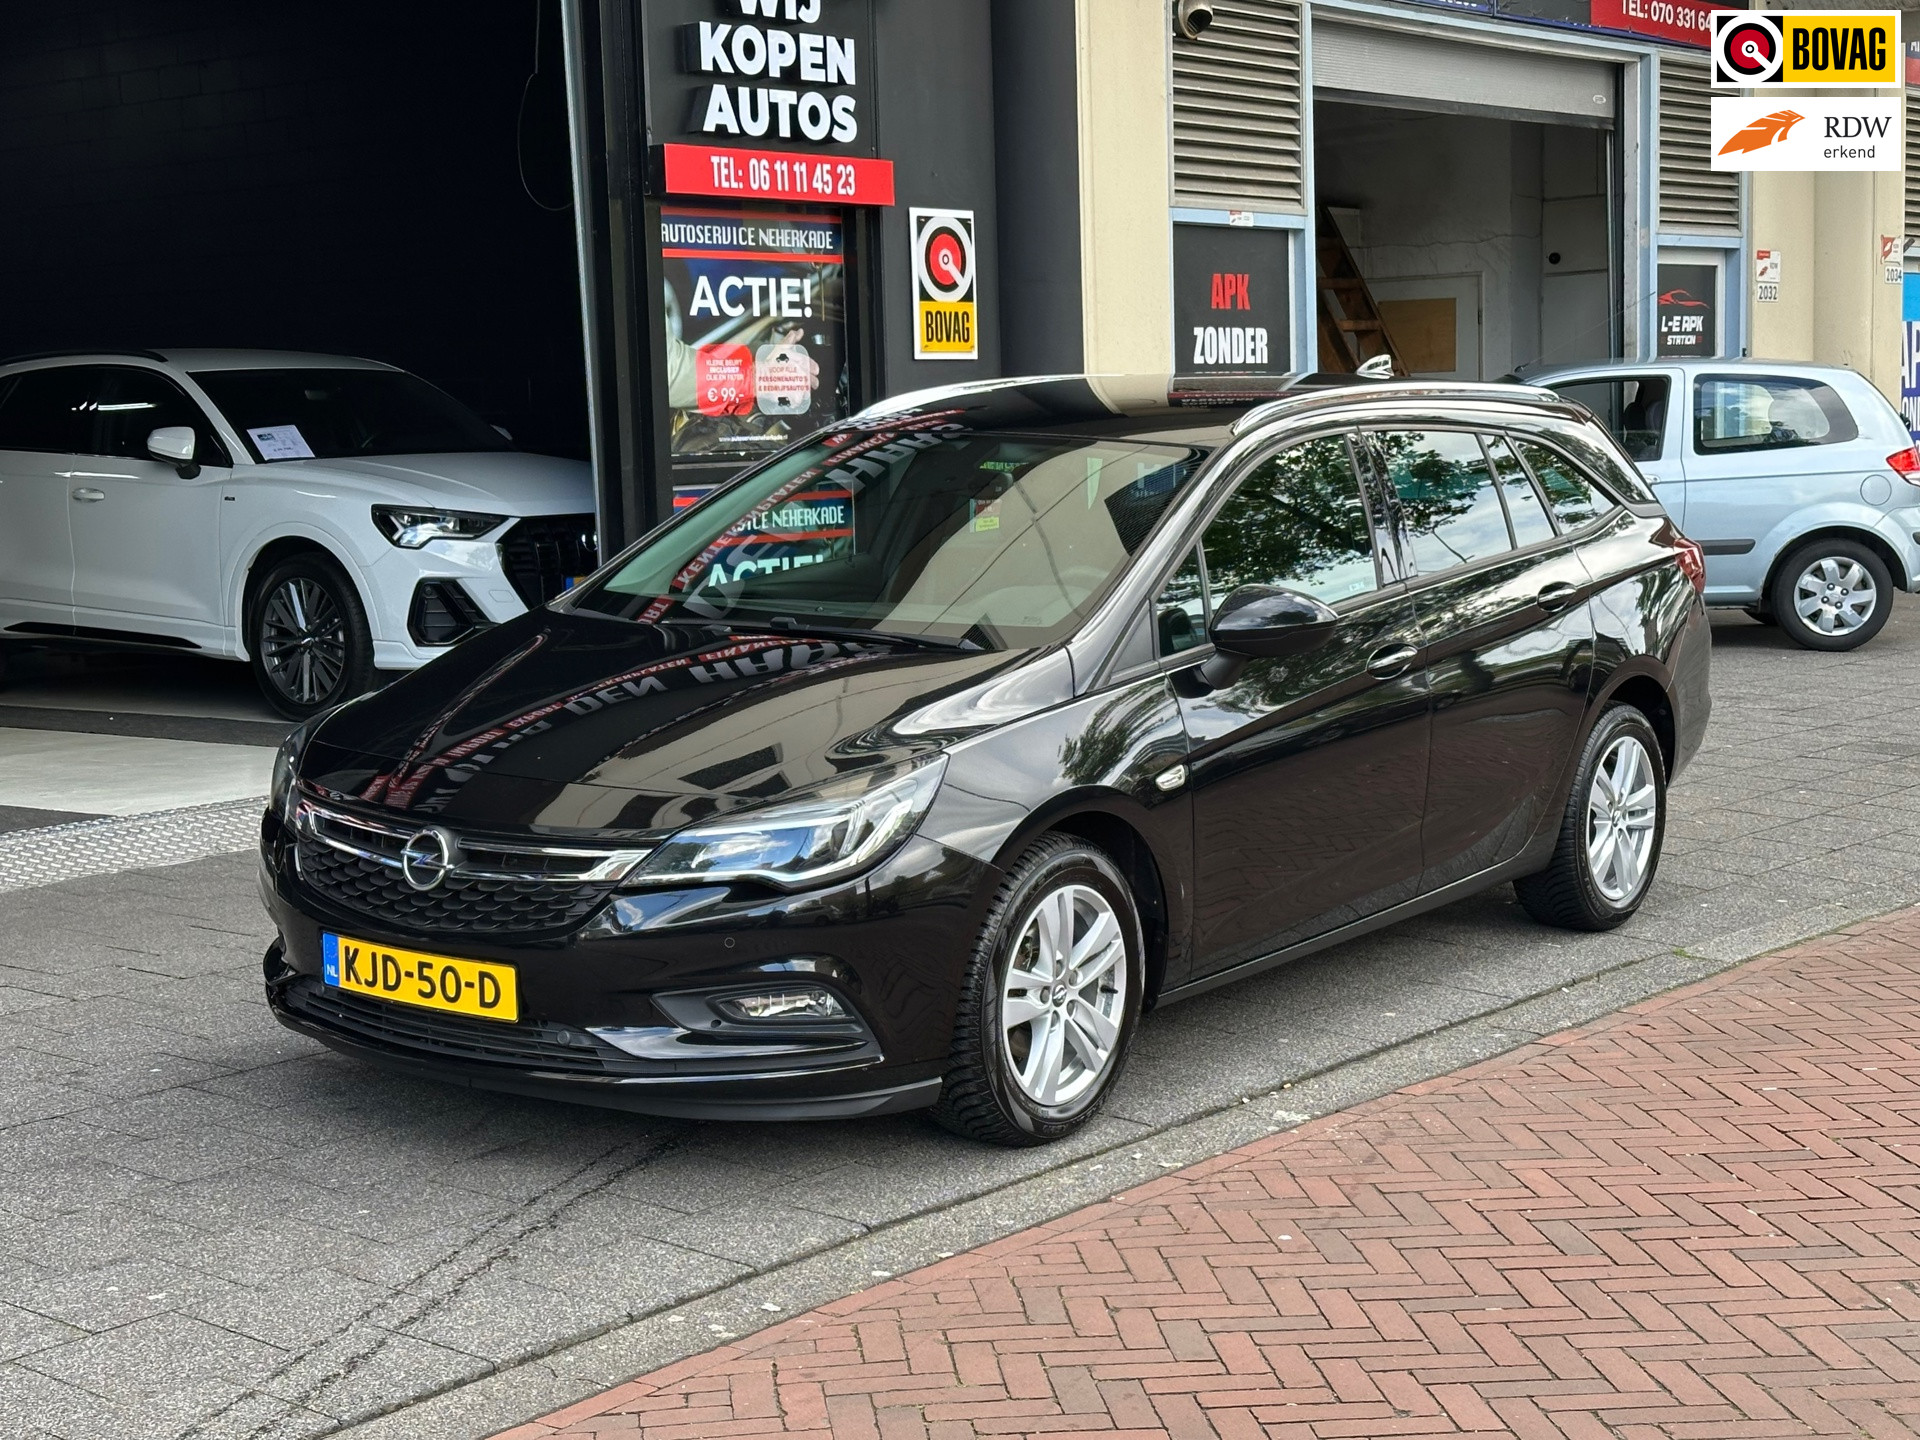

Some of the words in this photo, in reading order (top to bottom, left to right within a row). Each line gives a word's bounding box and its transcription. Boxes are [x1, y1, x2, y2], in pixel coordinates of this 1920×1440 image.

[1622, 0, 1648, 19] TEL:
[1651, 0, 1674, 25] 070
[1676, 6, 1696, 30] 331
[699, 20, 856, 86] KOPEN
[703, 83, 858, 143] AUTOS
[710, 155, 744, 189] TEL:
[748, 157, 771, 191] 06
[774, 160, 789, 192] 11
[793, 162, 808, 193] 11
[812, 163, 833, 195] 45
[836, 164, 856, 197] 23
[661, 222, 756, 246] AUTOSERVICE
[758, 228, 834, 250] NEHERKADE
[689, 275, 814, 319] ACTIE!
[1210, 272, 1251, 311] APK
[1758, 285, 1778, 300] 2032
[925, 310, 970, 343] BOVAG
[1660, 315, 1682, 332] L-E
[1681, 315, 1704, 332] APK
[1193, 326, 1268, 365] ZONDER
[1666, 335, 1697, 346] STATION
[707, 387, 719, 403] €
[772, 505, 845, 528] NEHERKADE
[326, 964, 339, 978] NL
[344, 945, 502, 1010] KJD-50-D
